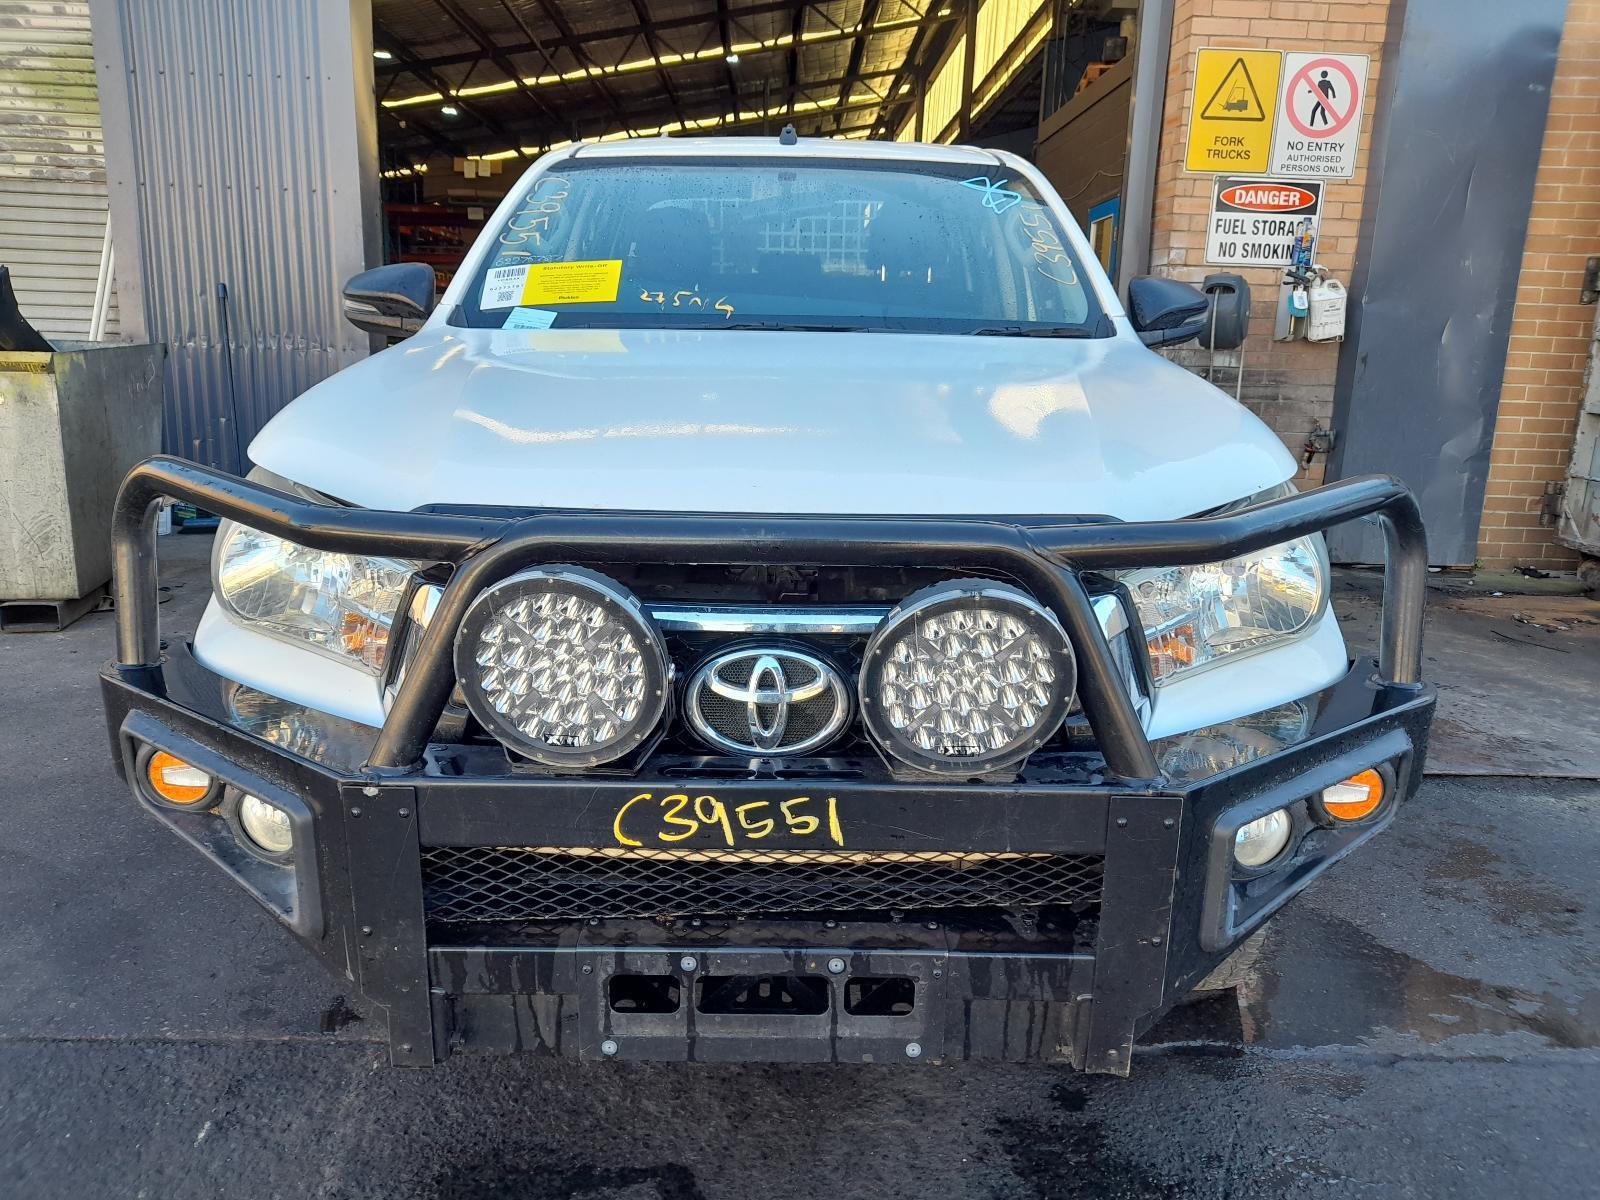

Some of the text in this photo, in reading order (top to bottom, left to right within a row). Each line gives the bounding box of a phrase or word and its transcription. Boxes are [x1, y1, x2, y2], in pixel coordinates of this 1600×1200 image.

[1213, 136, 1245, 147] FORK
[1287, 141, 1345, 152] NO ENTRY
[1206, 149, 1251, 160] TRUCKS
[1286, 154, 1342, 163] AUTHORISED
[1280, 163, 1345, 174] PERSONS ONLY
[1234, 189, 1301, 206] DANGER
[499, 177, 570, 256] C39551
[1215, 218, 1303, 237] FUEL STORA
[1018, 203, 1078, 285] C39551
[1218, 241, 1294, 260] NO SMOKIN
[613, 793, 844, 847] C39551
